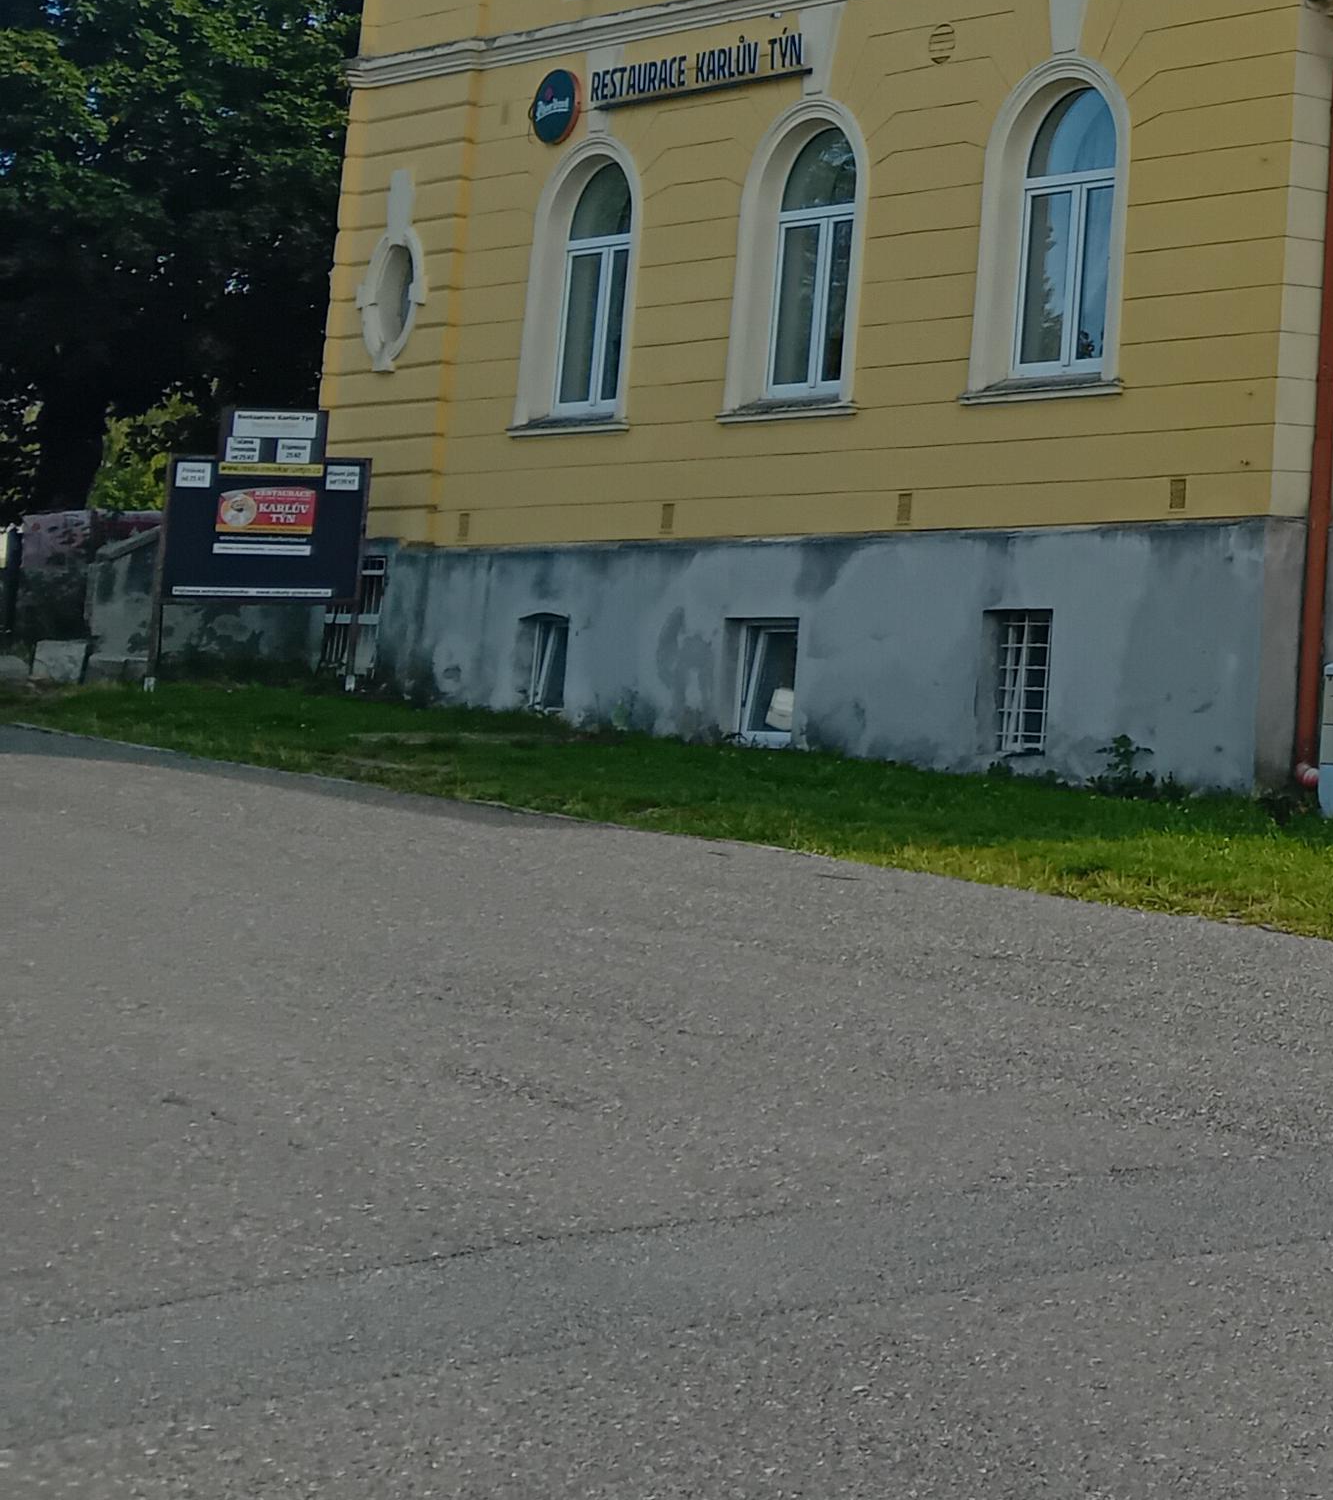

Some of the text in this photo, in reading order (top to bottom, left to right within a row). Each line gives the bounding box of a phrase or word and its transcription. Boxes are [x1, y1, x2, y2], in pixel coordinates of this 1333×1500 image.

[590, 26, 804, 102] RESTAURACE KARLŮV TÝN
